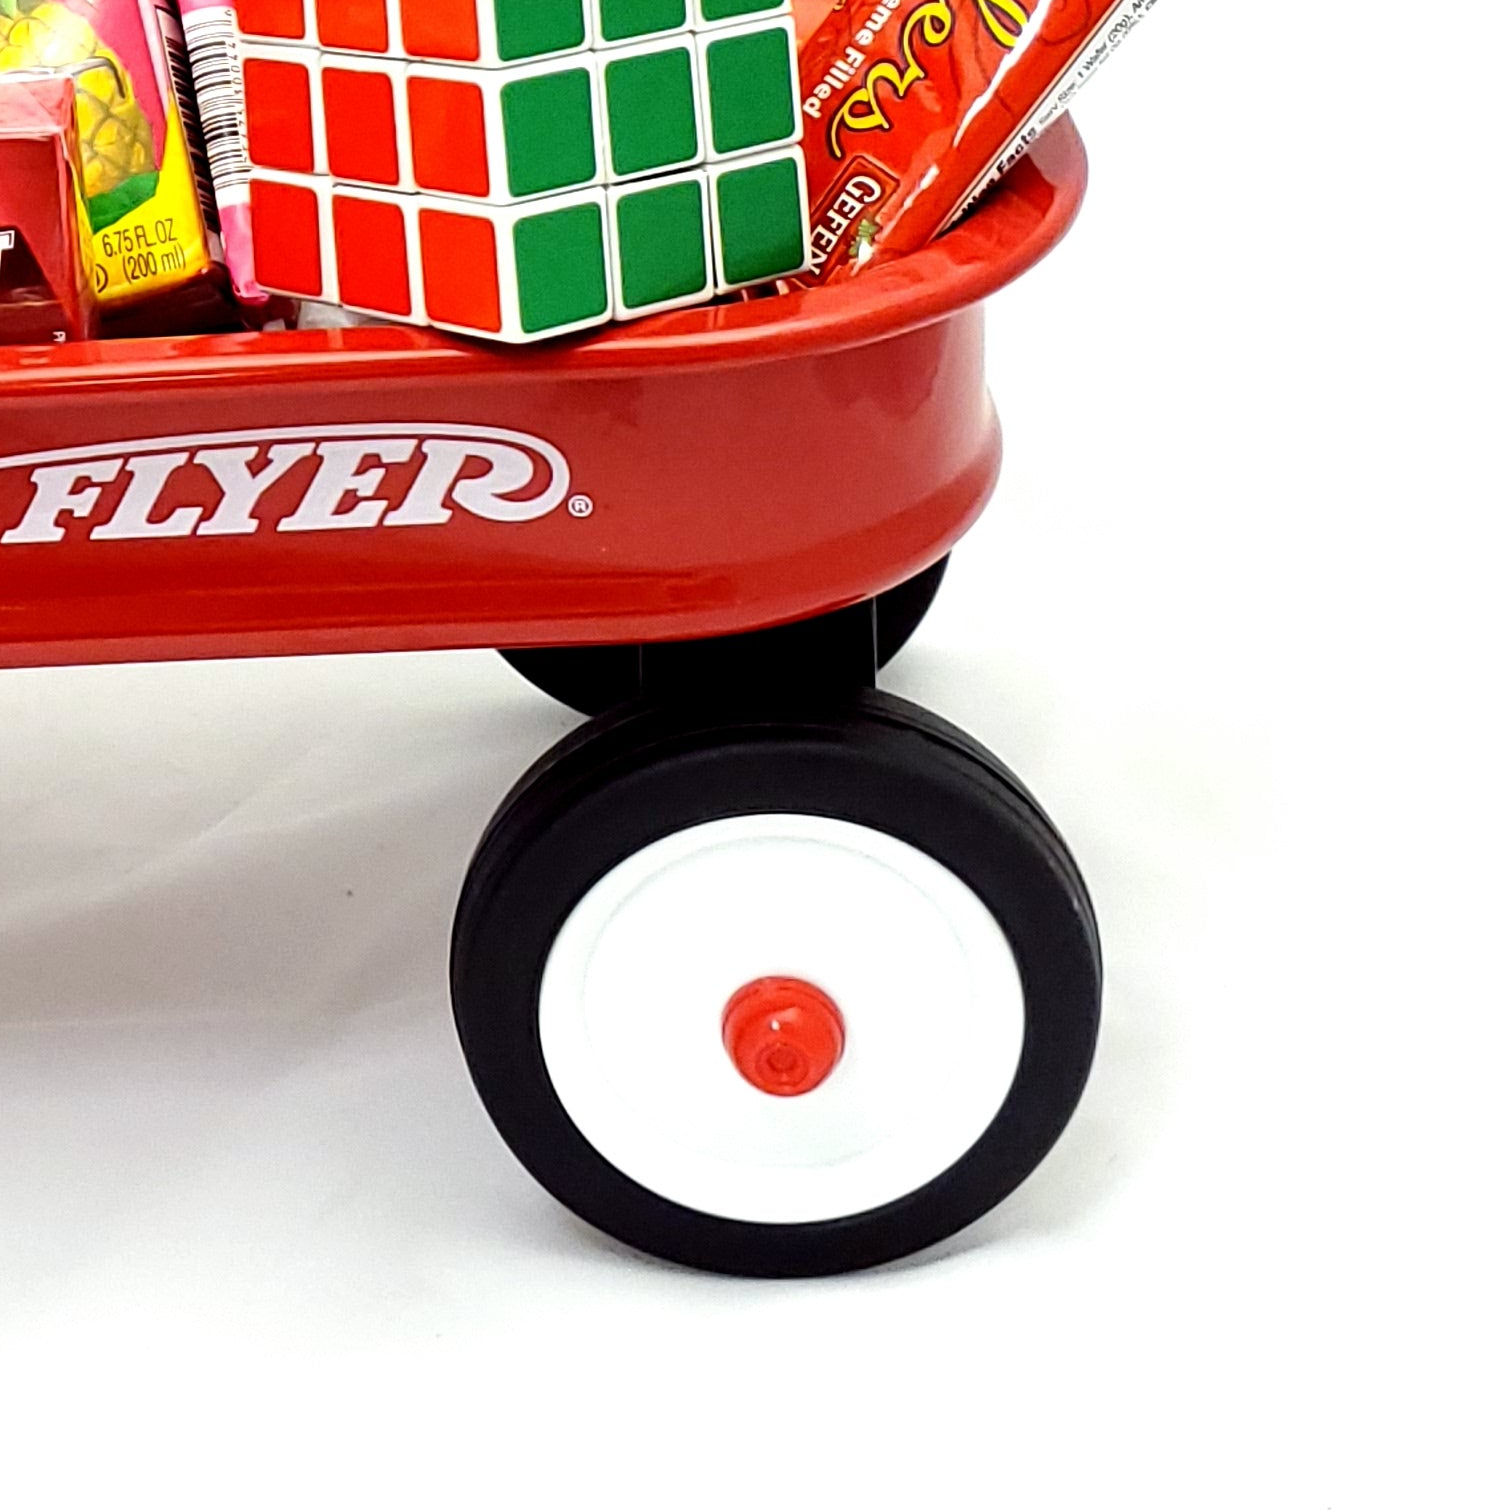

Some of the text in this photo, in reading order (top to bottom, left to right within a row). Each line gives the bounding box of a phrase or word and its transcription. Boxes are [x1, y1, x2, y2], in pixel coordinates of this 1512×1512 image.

[801, 44, 864, 119] Filled
[101, 228, 134, 258] 6.75
[155, 218, 178, 244] OZ
[122, 241, 186, 284] (200 ml)
[808, 175, 882, 276] GEFEN
[0, 423, 575, 545] FLYER
